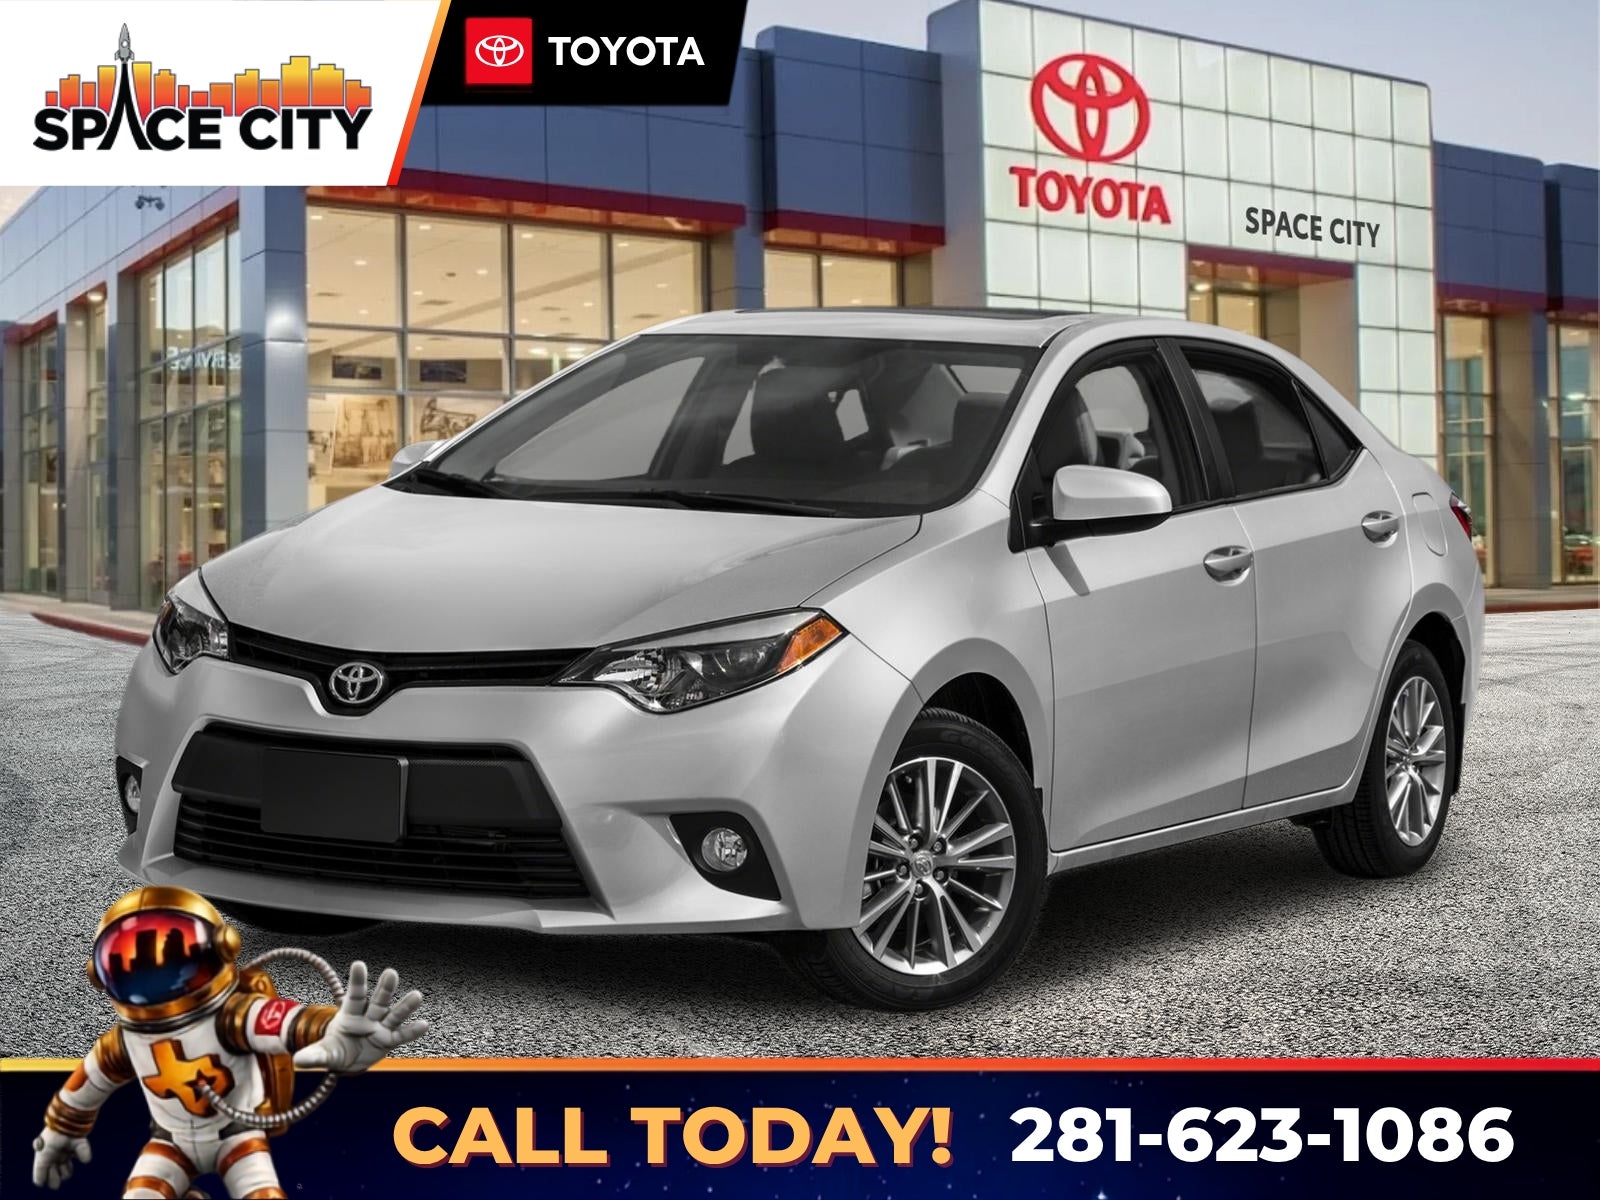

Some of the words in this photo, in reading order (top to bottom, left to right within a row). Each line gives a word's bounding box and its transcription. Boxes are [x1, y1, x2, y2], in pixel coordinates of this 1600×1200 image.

[1009, 166, 1171, 224] TOYOTA
[1245, 206, 1322, 241] SPACE
[1329, 218, 1380, 248] CITY
